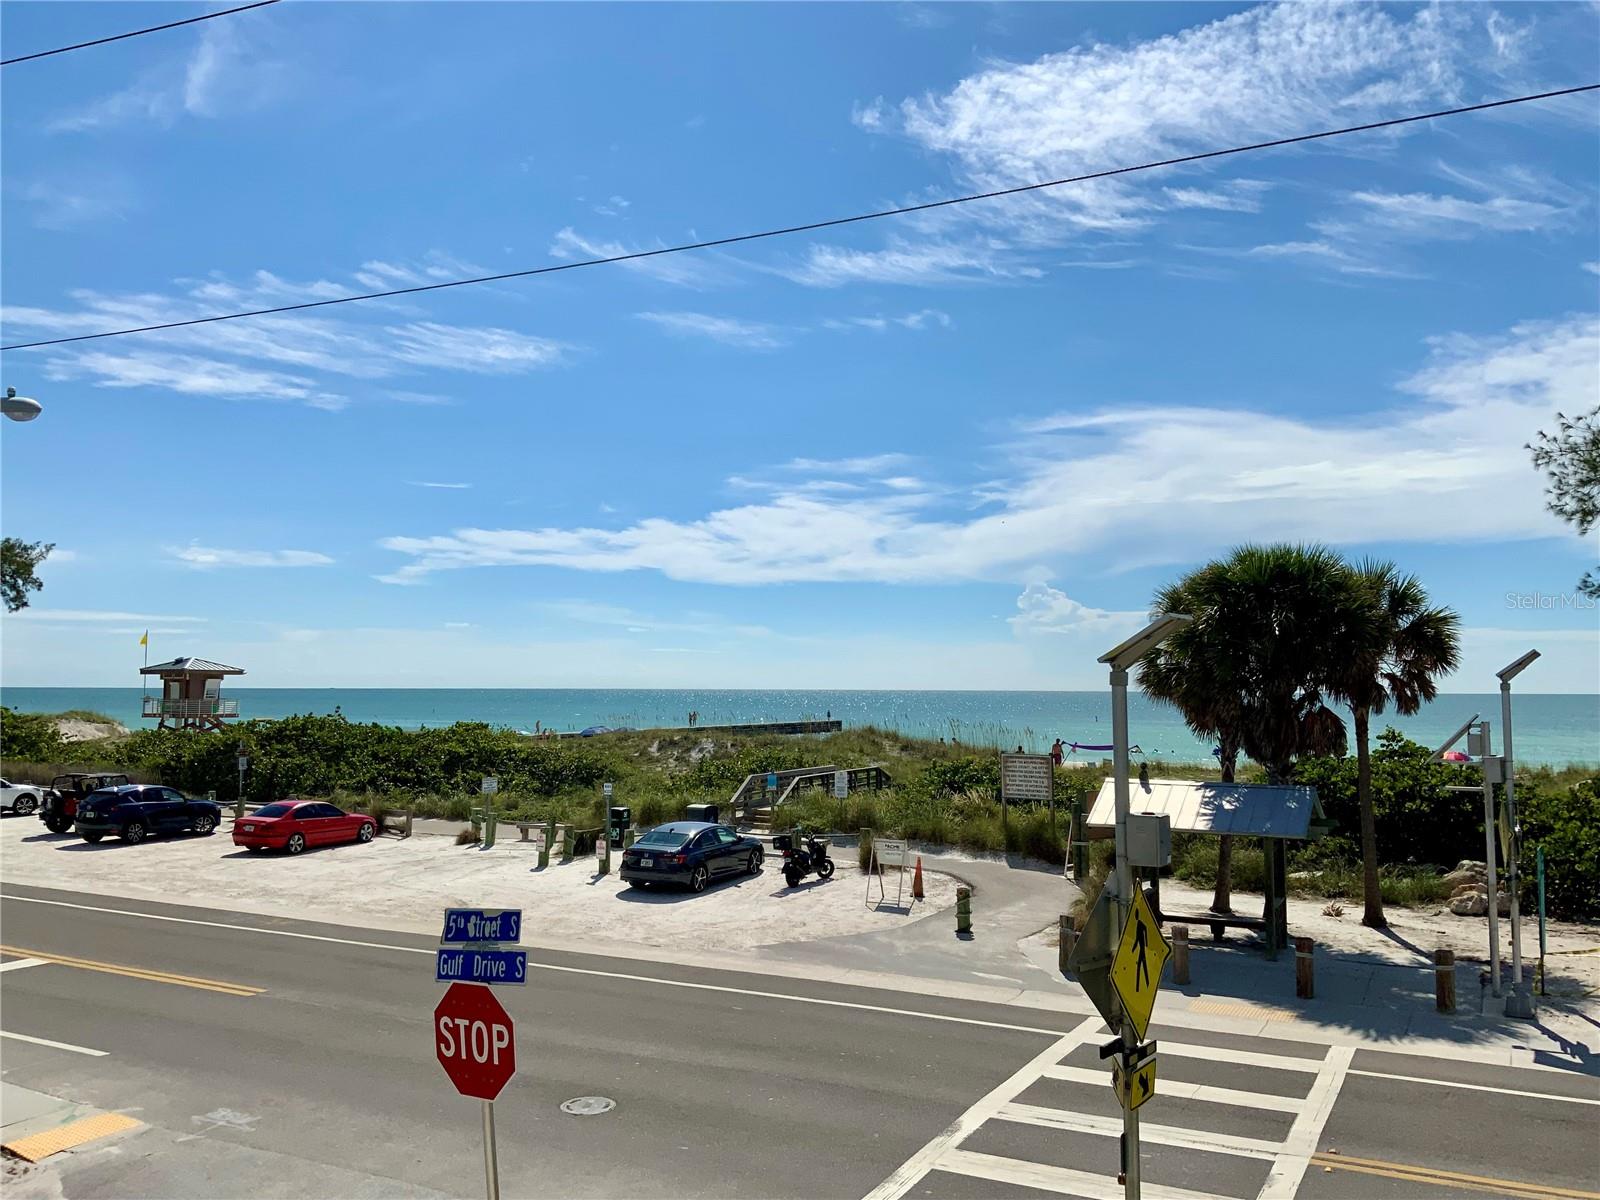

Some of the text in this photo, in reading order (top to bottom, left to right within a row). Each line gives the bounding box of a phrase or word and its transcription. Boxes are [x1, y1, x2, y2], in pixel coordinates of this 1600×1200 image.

[467, 914, 502, 938] Street
[509, 915, 518, 937] S
[440, 953, 524, 978] Gulf Drive S
[439, 1015, 510, 1066] STOP
